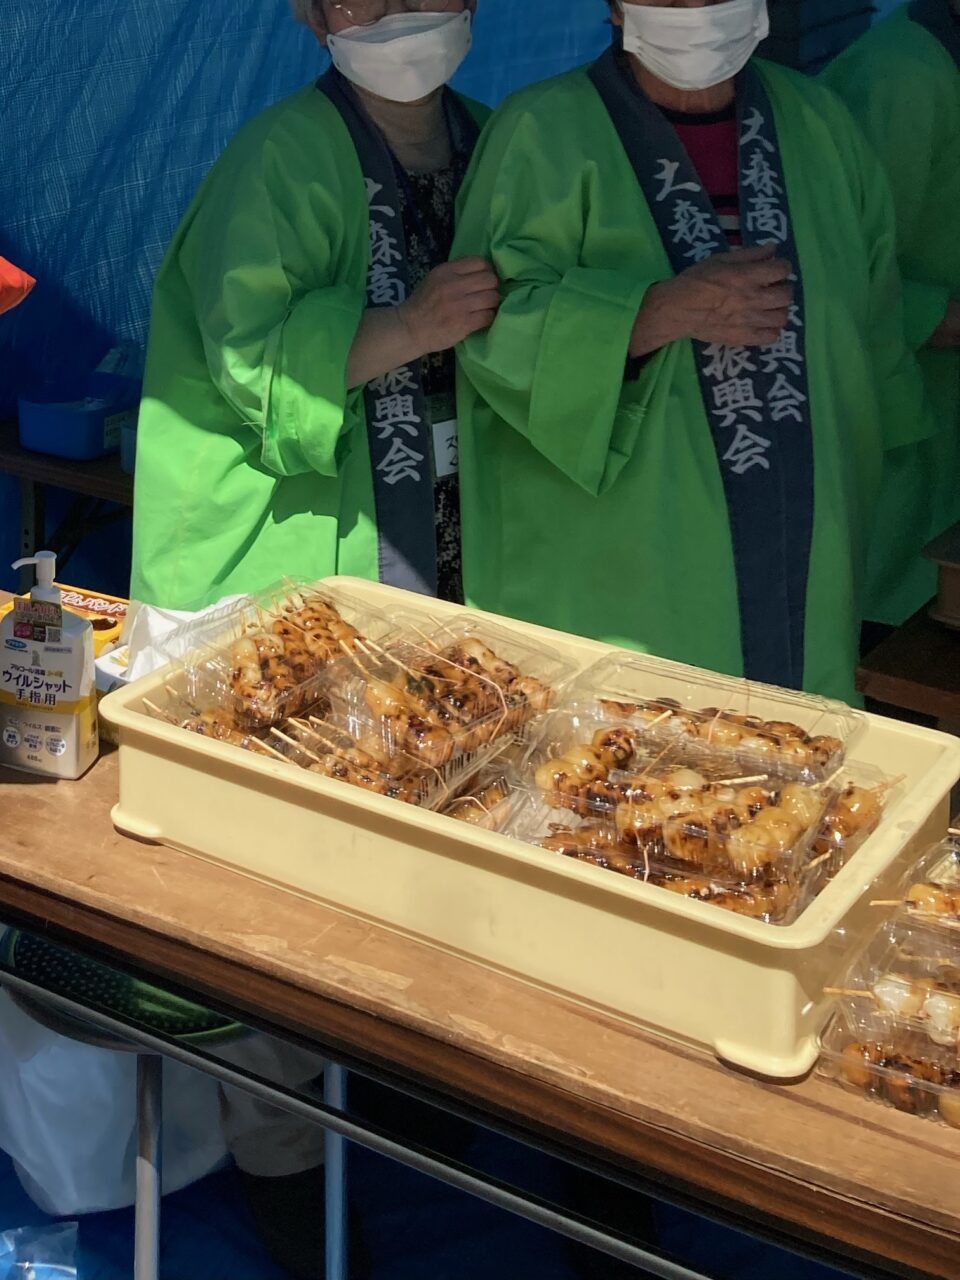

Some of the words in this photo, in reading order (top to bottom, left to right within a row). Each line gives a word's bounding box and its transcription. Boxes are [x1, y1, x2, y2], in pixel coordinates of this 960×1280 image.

[2, 669, 73, 693] ウイルシャット
[16, 688, 56, 706] 手指用
